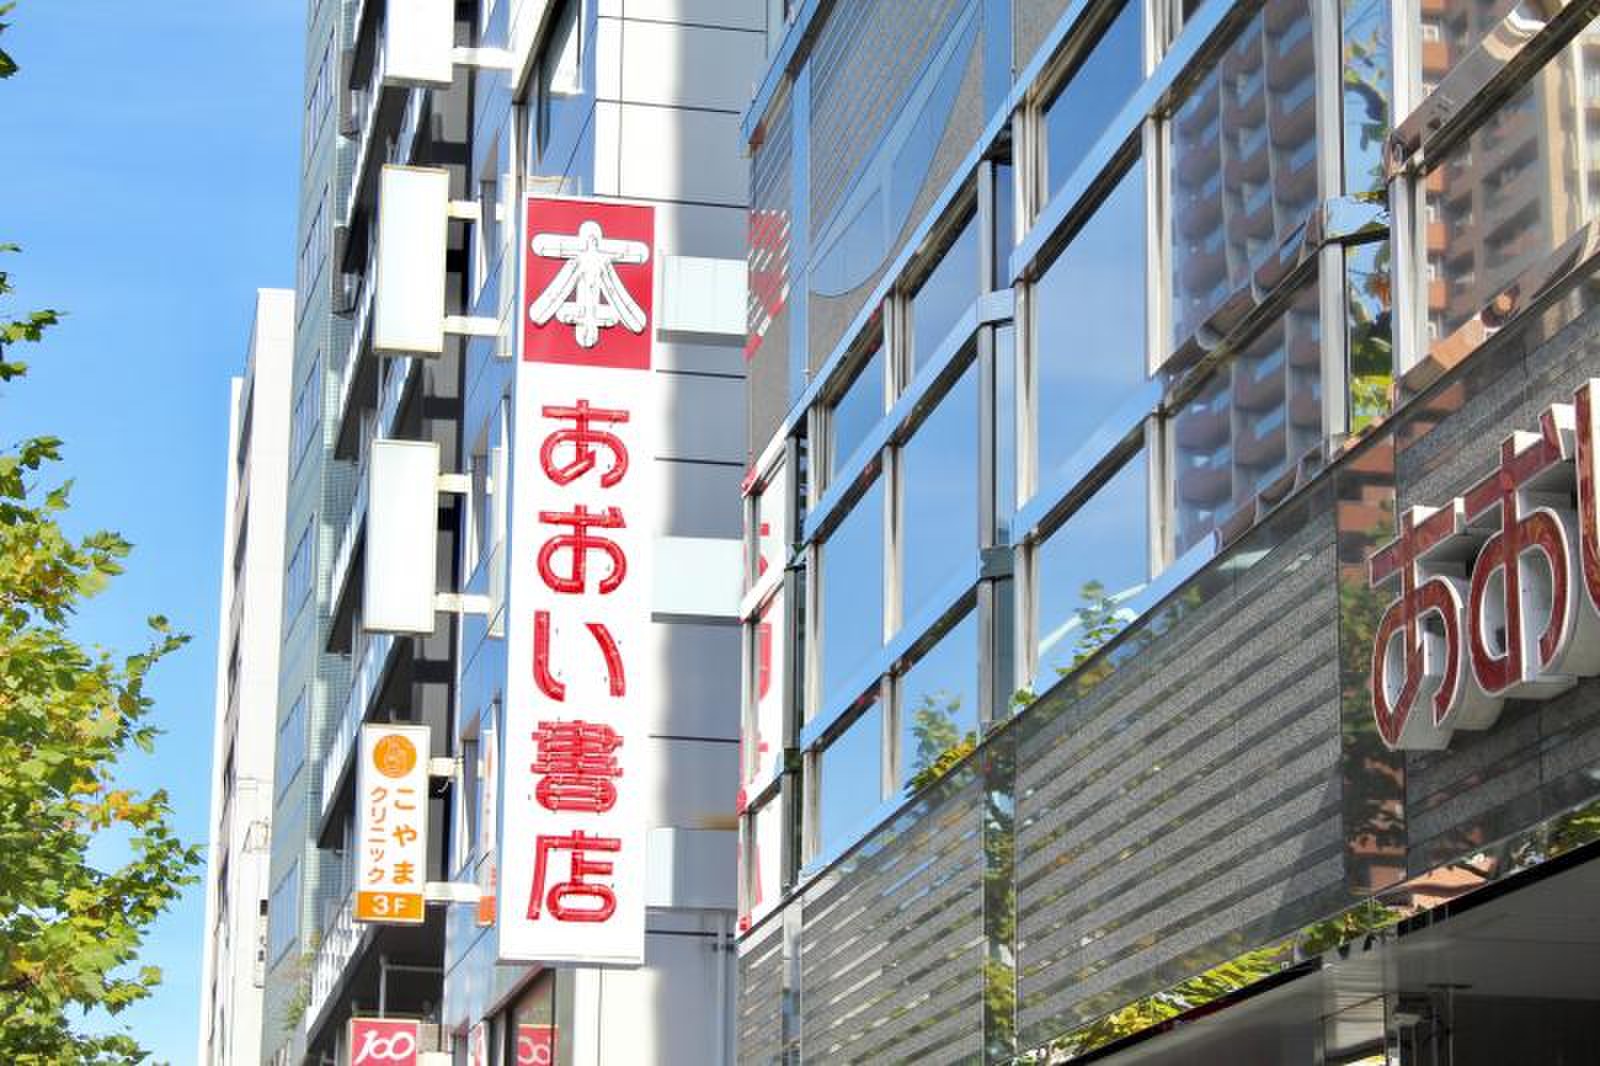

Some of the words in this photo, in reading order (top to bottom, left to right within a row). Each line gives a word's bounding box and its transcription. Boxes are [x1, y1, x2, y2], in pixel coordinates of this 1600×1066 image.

[529, 220, 650, 349] 本
[526, 398, 630, 923] あおい書店
[367, 786, 388, 885] クリニック
[392, 787, 417, 885] こやま
[371, 894, 409, 916] 3F
[354, 1029, 416, 1066] 100
